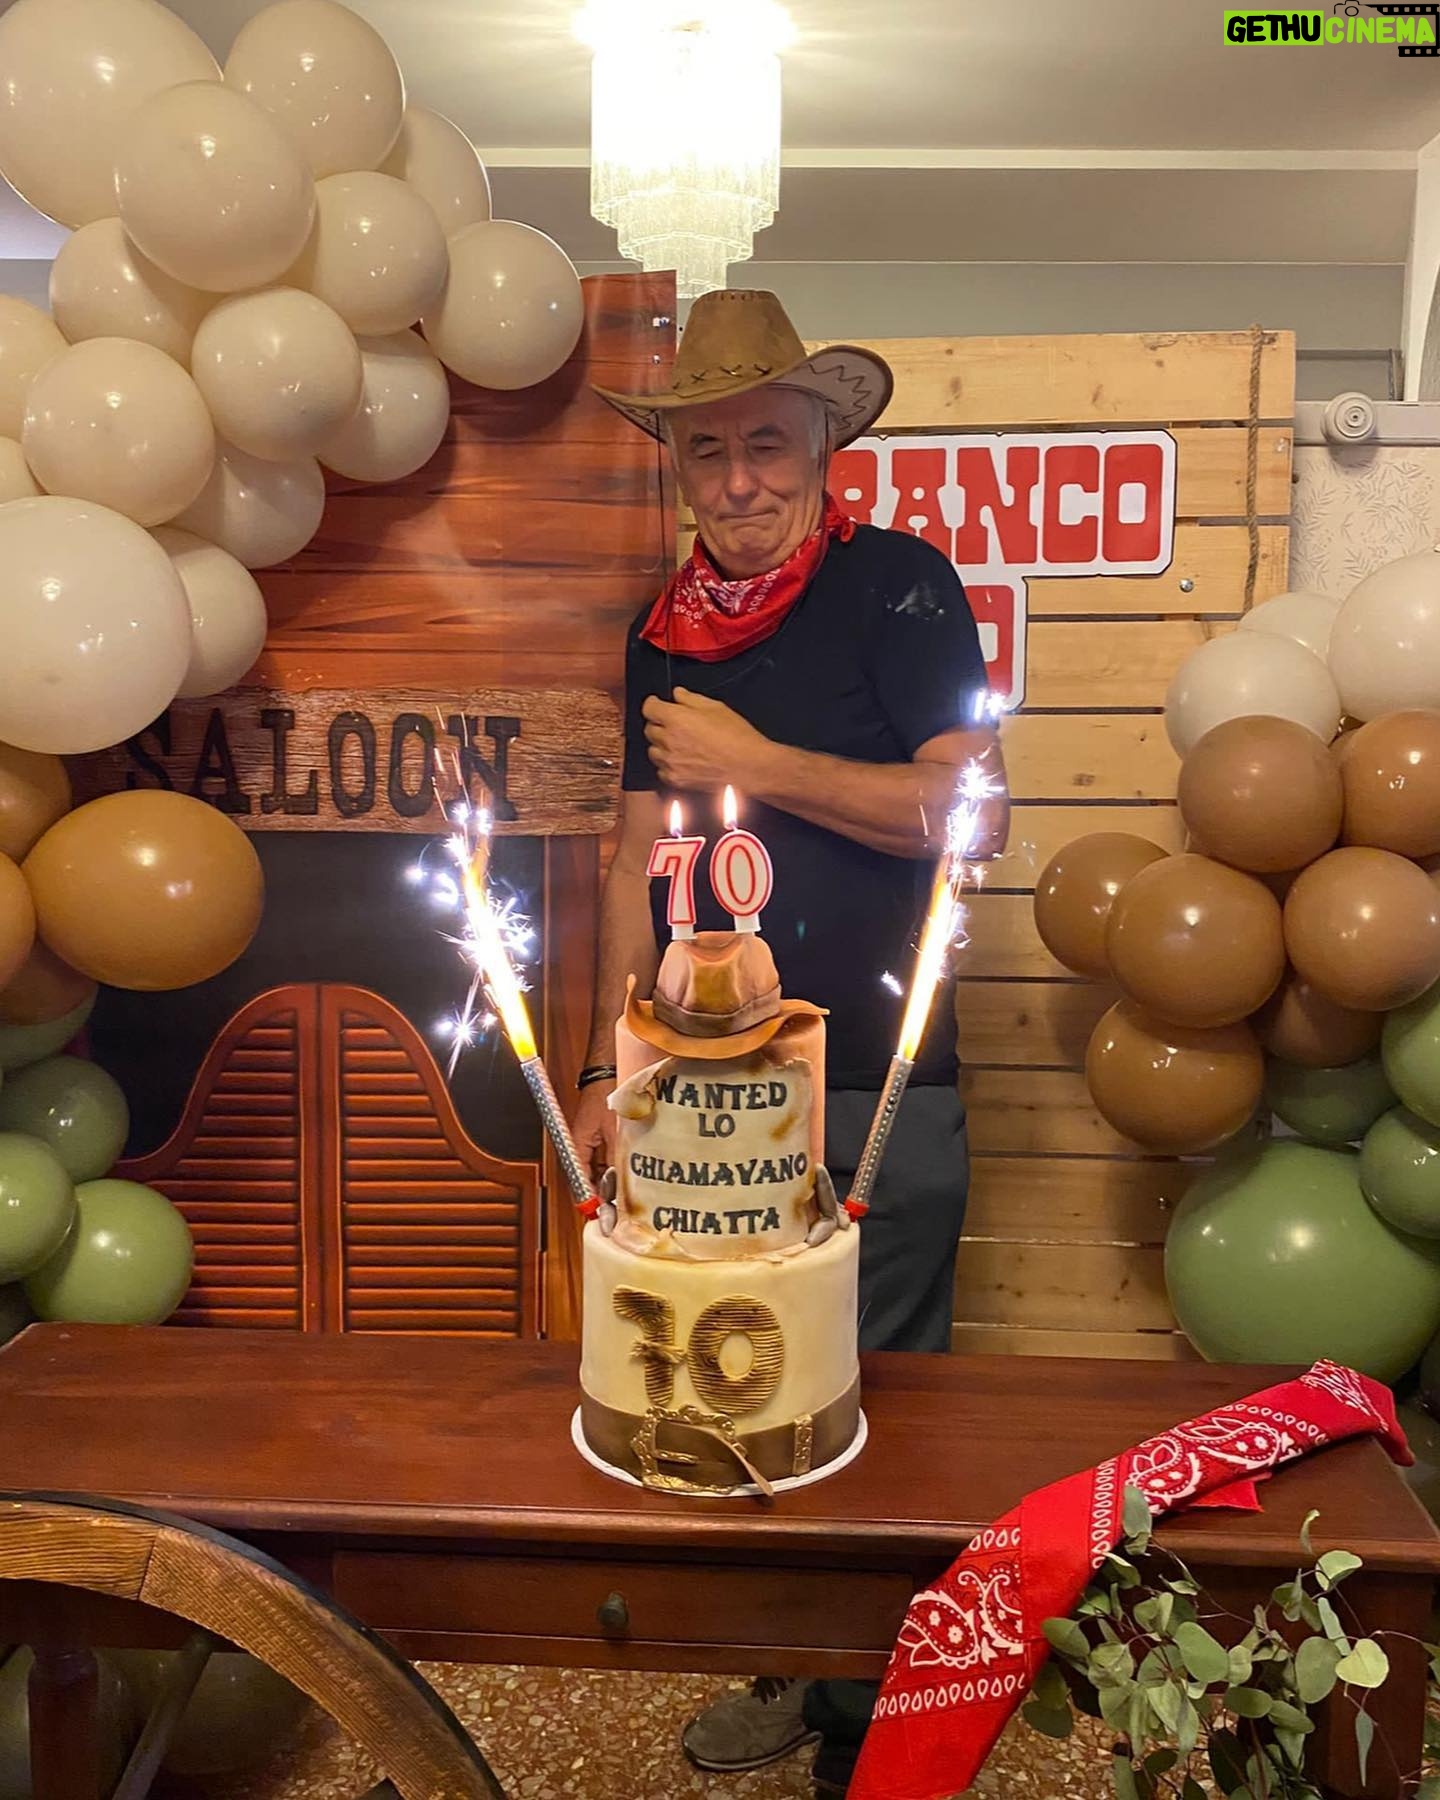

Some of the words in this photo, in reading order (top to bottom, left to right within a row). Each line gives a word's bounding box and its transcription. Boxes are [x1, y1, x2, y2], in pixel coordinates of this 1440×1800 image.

[646, 828, 773, 926] 70
[655, 1074, 788, 1111] WANTED
[697, 1113, 736, 1138] LO
[629, 1151, 808, 1187] CHIAMAVANO
[652, 1206, 781, 1235] CHIATTA
